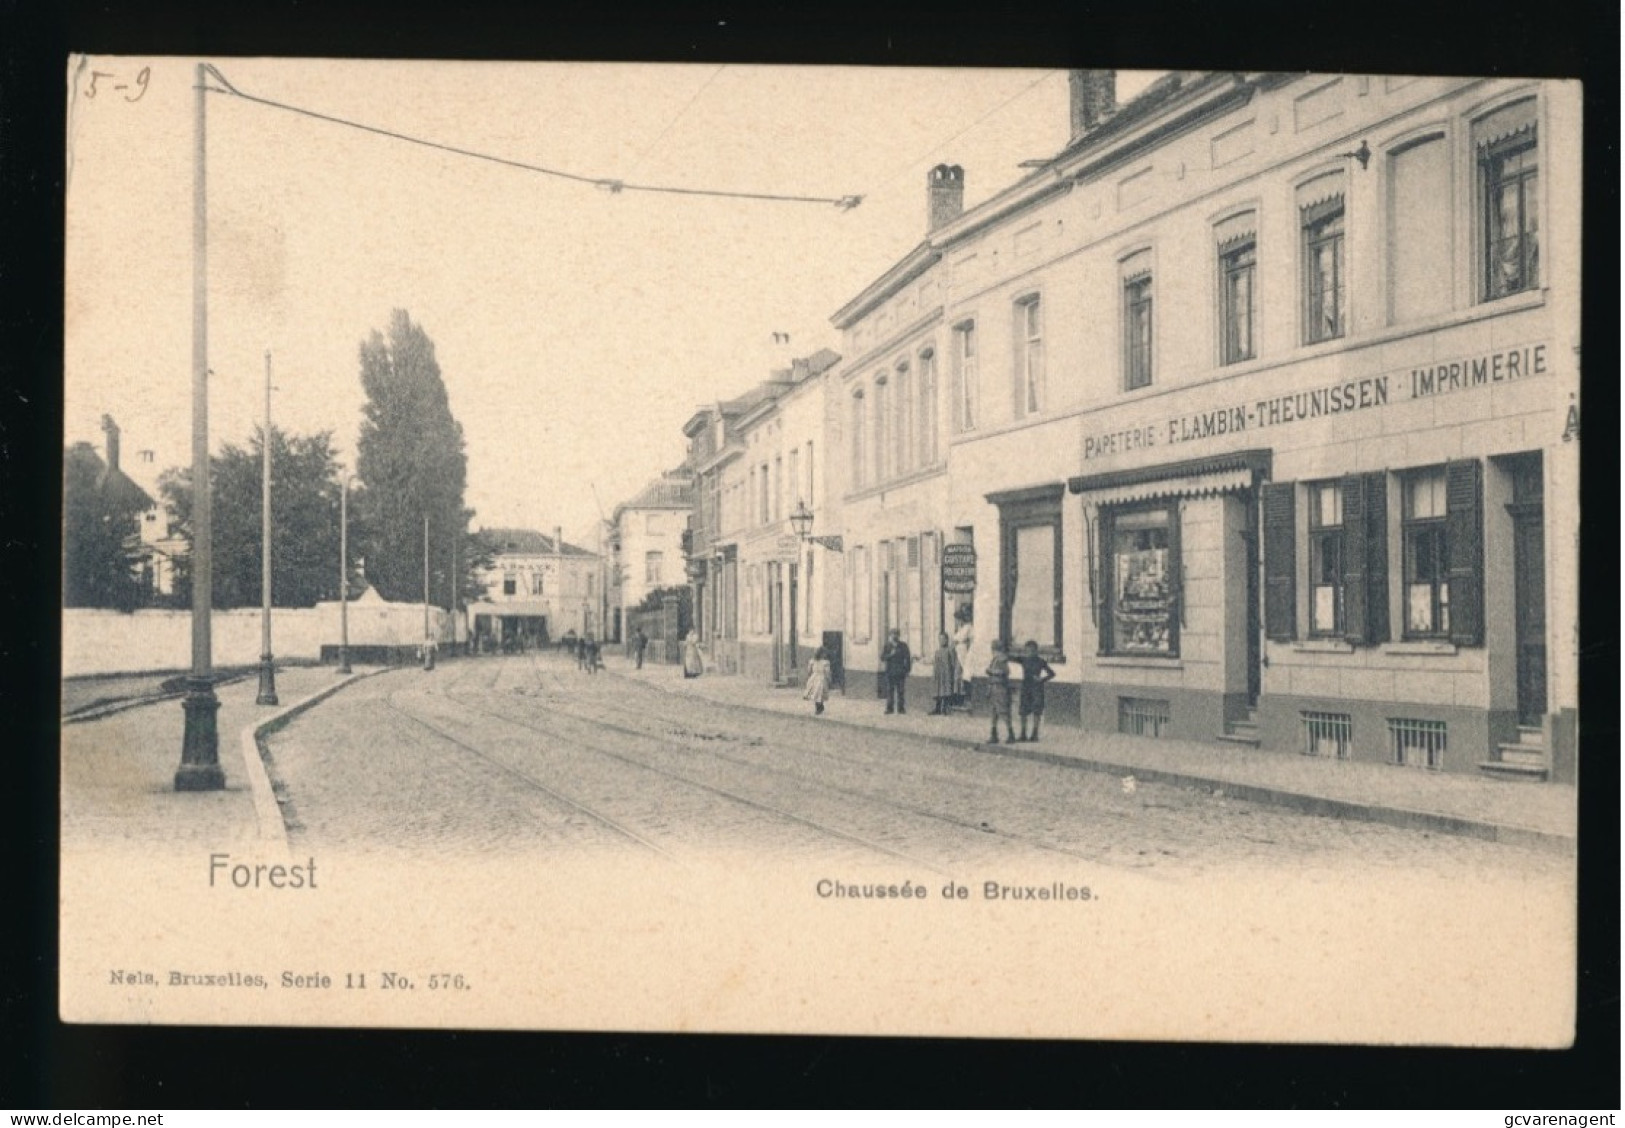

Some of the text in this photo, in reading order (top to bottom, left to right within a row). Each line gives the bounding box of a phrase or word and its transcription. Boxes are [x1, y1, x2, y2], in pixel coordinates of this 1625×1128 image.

[83, 66, 151, 103] 5-9
[1084, 425, 1155, 459] PAPETERIE
[1410, 344, 1547, 399] IMPRIMERIE
